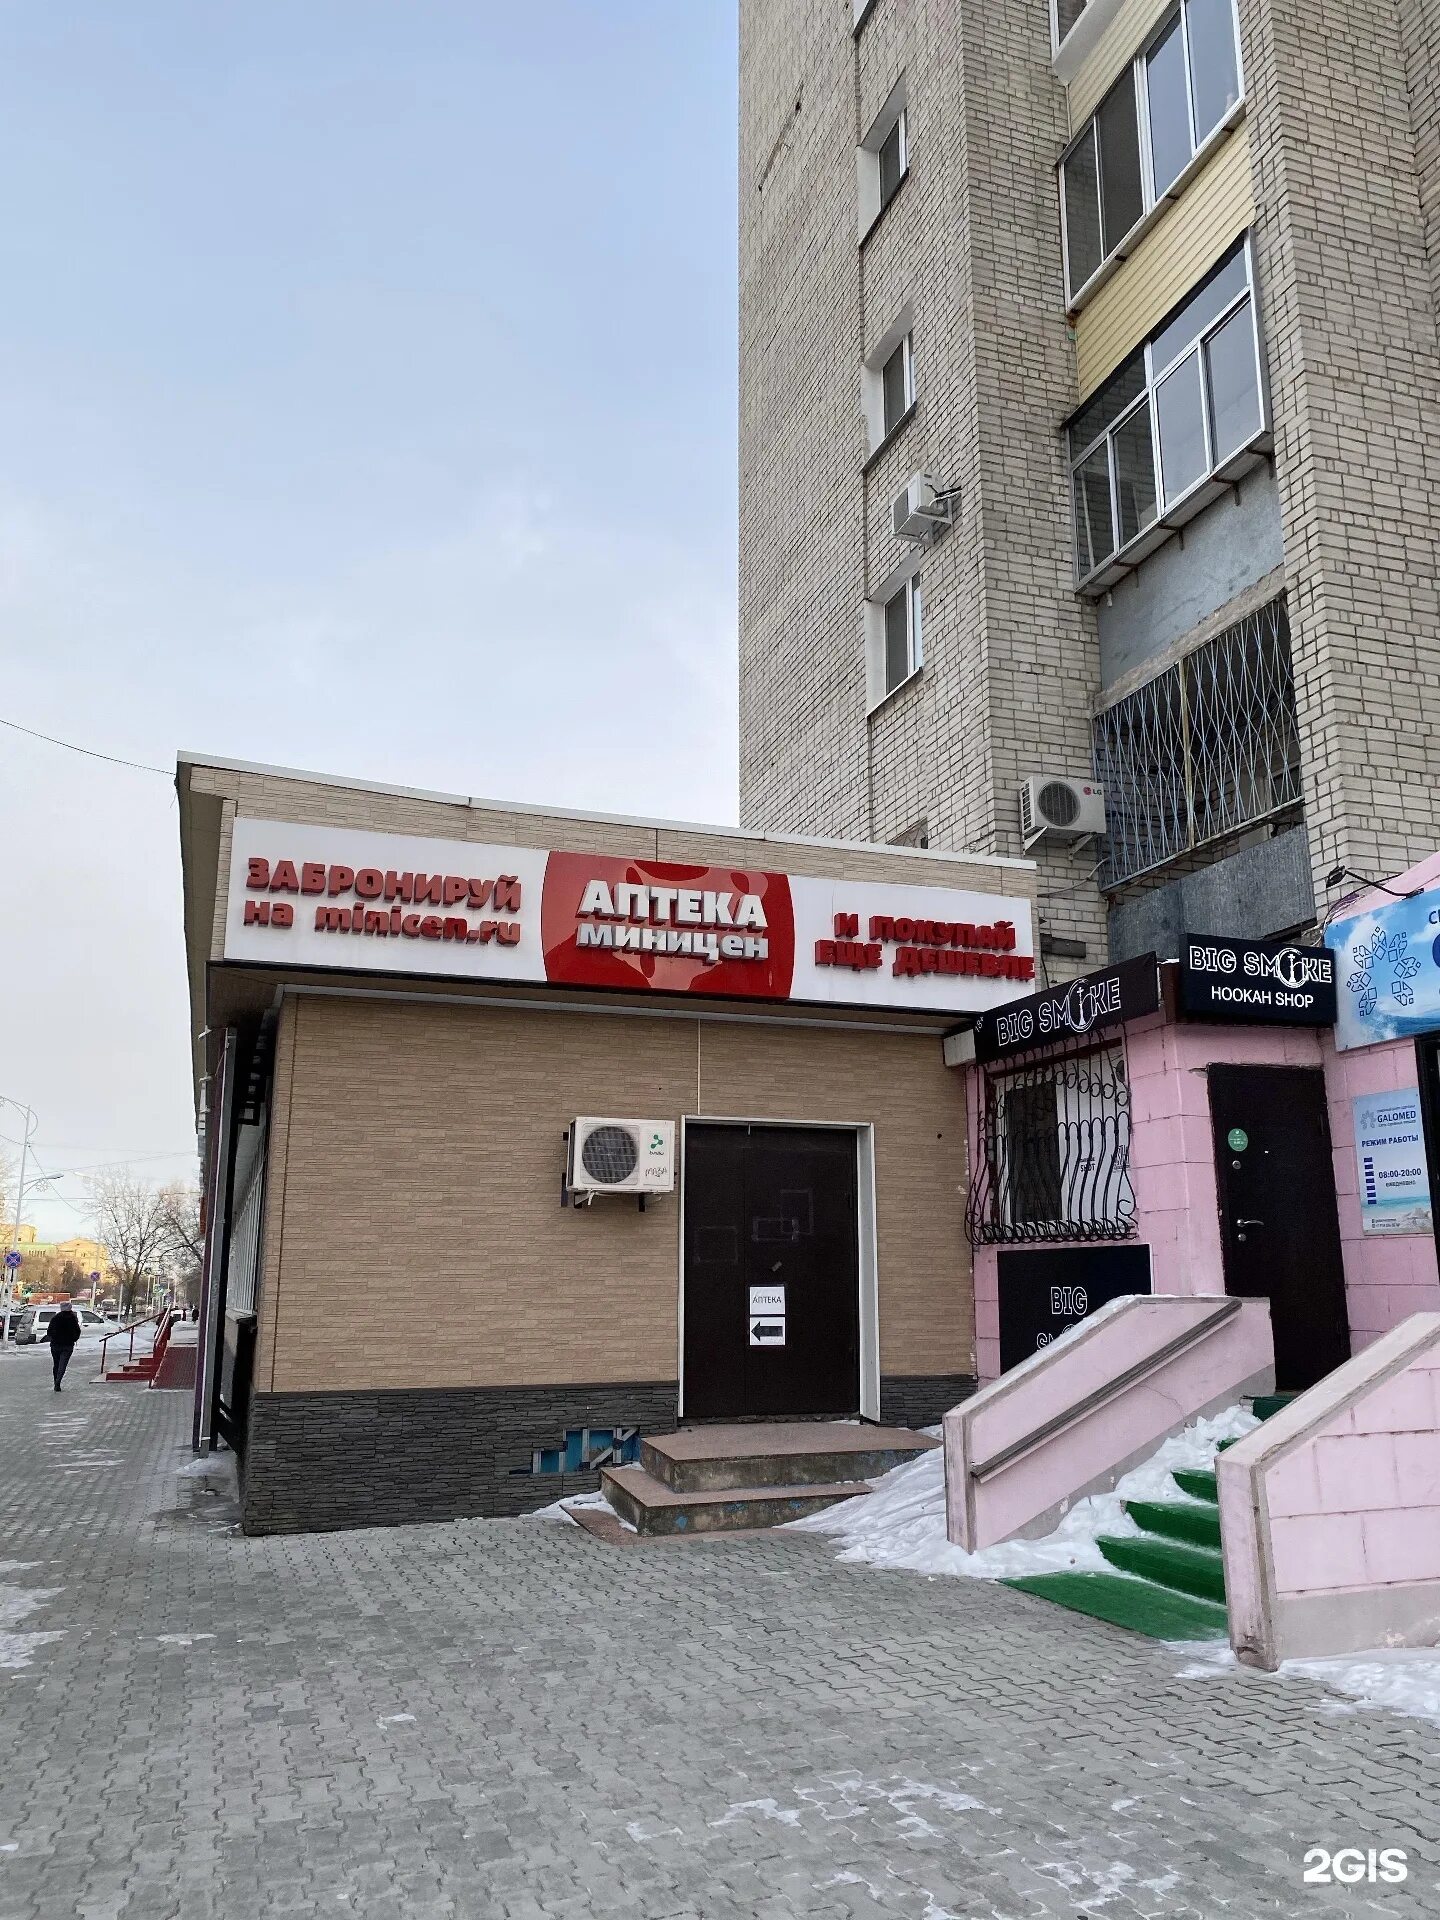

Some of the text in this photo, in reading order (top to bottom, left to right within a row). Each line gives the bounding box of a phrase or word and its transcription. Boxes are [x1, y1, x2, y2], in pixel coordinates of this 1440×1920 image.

[246, 857, 521, 912] ЗАБРОНИРУЙ
[577, 879, 769, 930] АПТЕКА
[244, 900, 521, 947] на minicen.ru
[834, 912, 1016, 951] И ПОКУПАЙ
[815, 939, 1035, 981] ЕЩЕ ДЕШЕВЛЕ
[1189, 946, 1237, 973] BIG
[1211, 985, 1314, 1008] HOOKAH SHOP
[996, 1009, 1034, 1046] BIG
[1377, 1110, 1417, 1123] GALOMED
[1361, 1134, 1419, 1148] РЕЖИМ РАБОТЫ
[1378, 1167, 1422, 1179] 08:00-20:00
[752, 1295, 782, 1304] АПТЕКА
[1050, 1286, 1088, 1316] BIG
